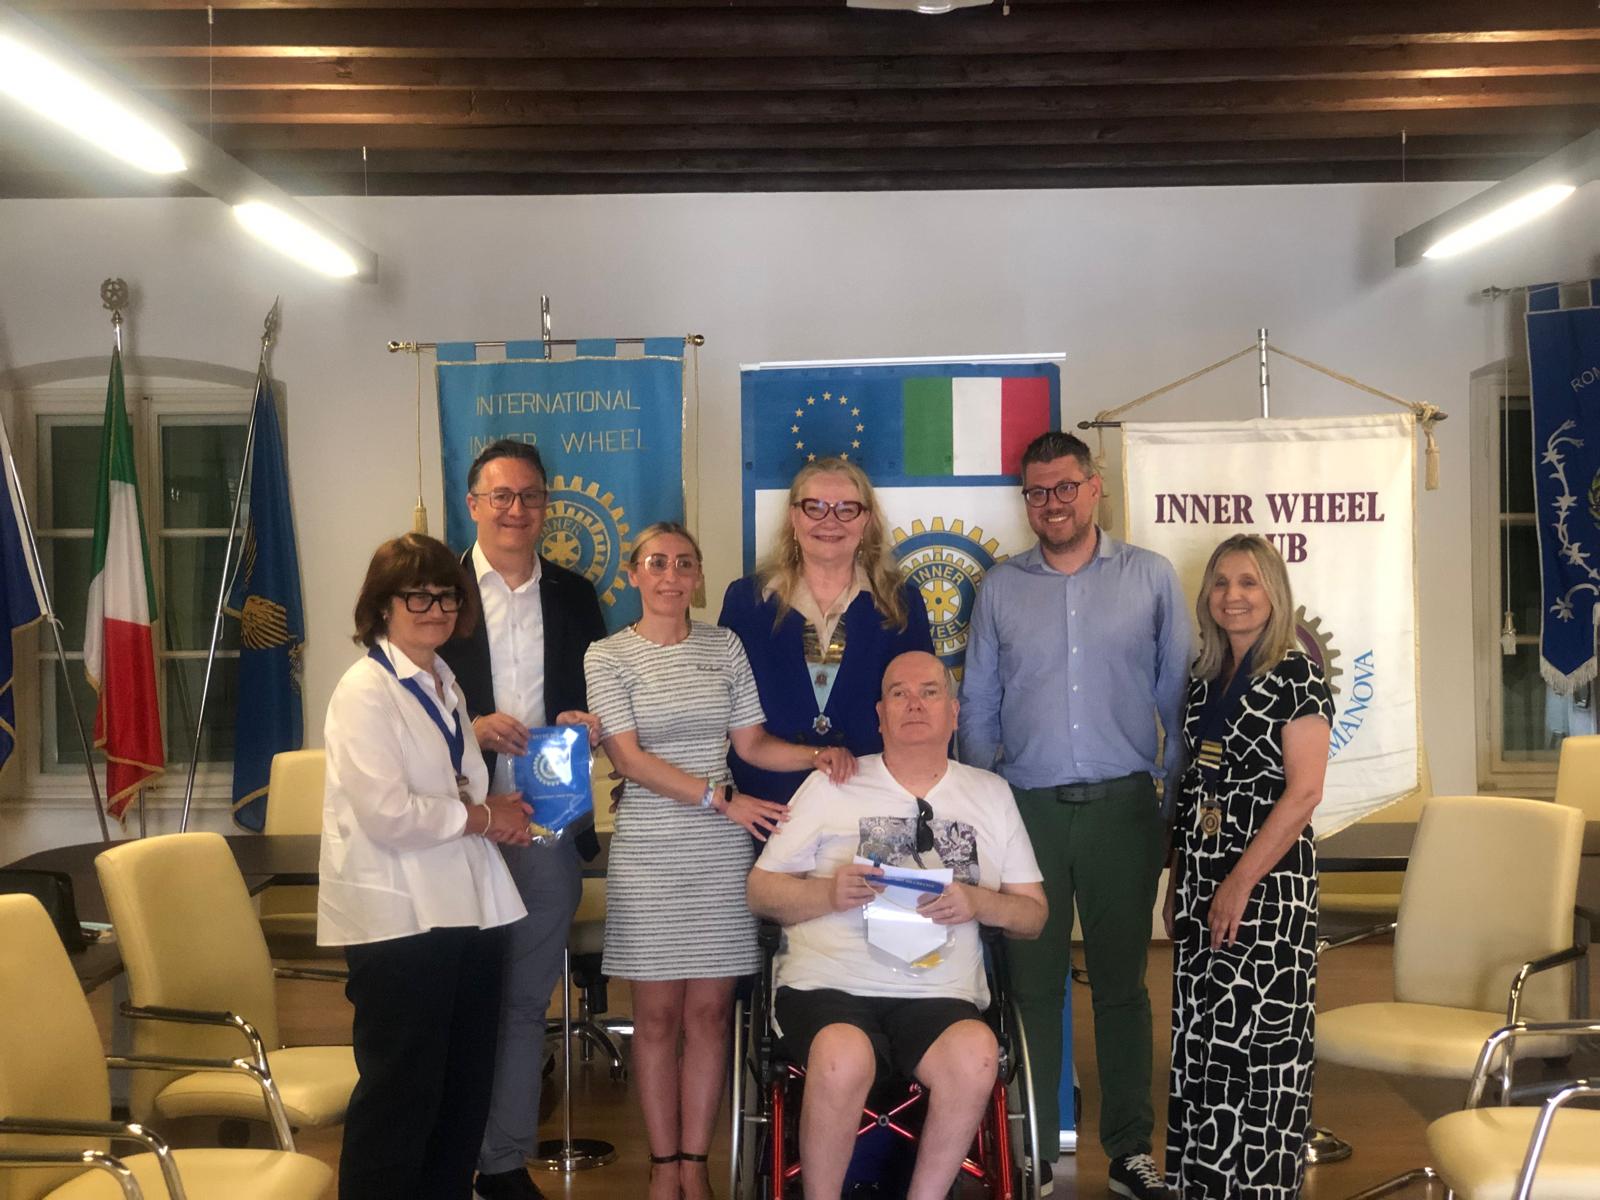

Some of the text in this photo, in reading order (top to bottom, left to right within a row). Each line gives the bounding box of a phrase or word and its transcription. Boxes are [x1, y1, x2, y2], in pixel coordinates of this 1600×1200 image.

[476, 389, 641, 416] INTERNATIONAL
[560, 428, 647, 454] WHEEL
[1154, 491, 1385, 525] INNER WHEEL
[1247, 533, 1308, 563] UB
[912, 565, 965, 586] INNER
[929, 619, 969, 639] EEL
[1328, 649, 1375, 760] MANOVA
